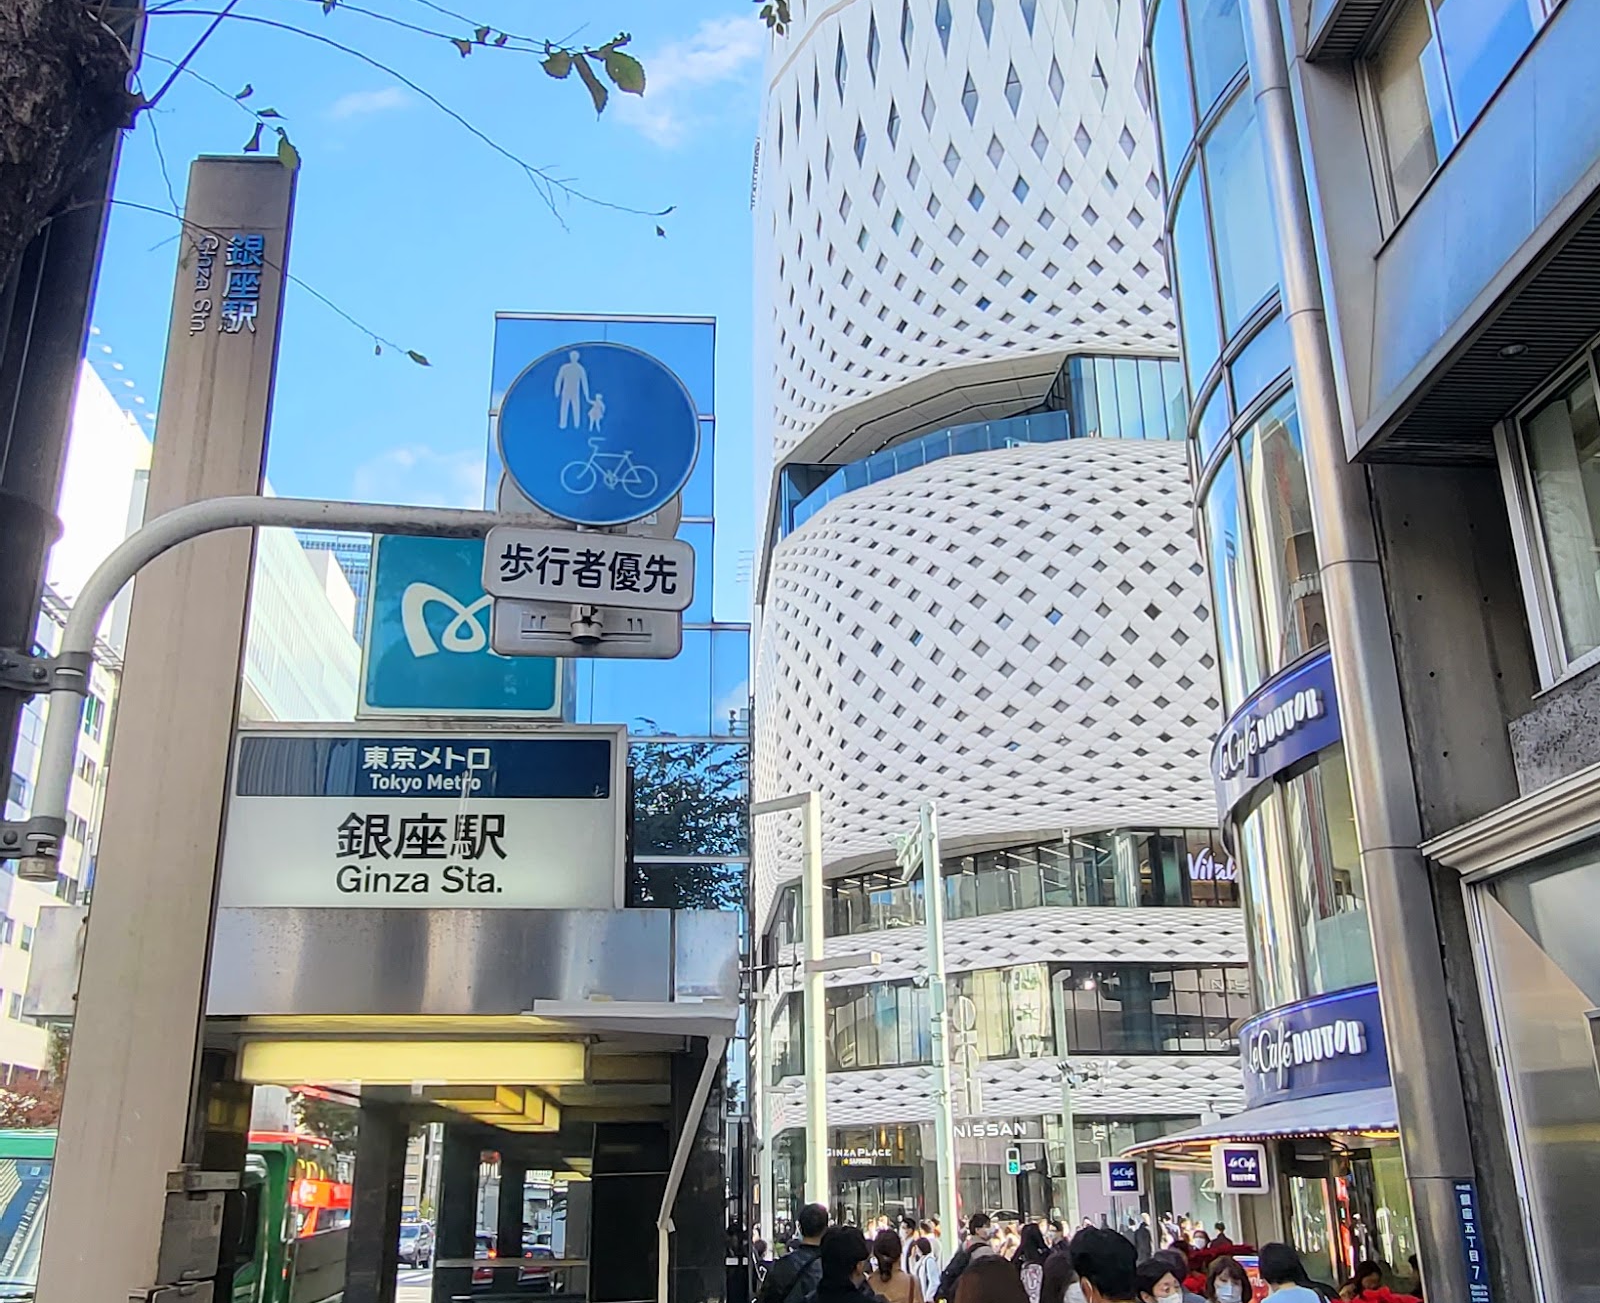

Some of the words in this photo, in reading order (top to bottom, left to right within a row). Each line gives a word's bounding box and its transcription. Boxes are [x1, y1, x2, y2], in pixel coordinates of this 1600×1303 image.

[194, 235, 219, 293] Ginza
[218, 233, 265, 333] 銀座駅
[188, 298, 213, 337] Stn.
[499, 542, 678, 595] 歩行者優先
[1256, 688, 1322, 749] DOUTOR
[361, 746, 491, 771] 東京メトロ
[369, 773, 423, 795] Tokyo
[426, 773, 482, 792] Metro
[335, 811, 508, 861] 銀座駅
[335, 864, 430, 894] Ginza
[440, 864, 503, 894] Sta.
[1291, 1019, 1365, 1066] DOUTOR
[952, 1121, 1028, 1139] NISSAN
[857, 1147, 892, 1157] PLACE
